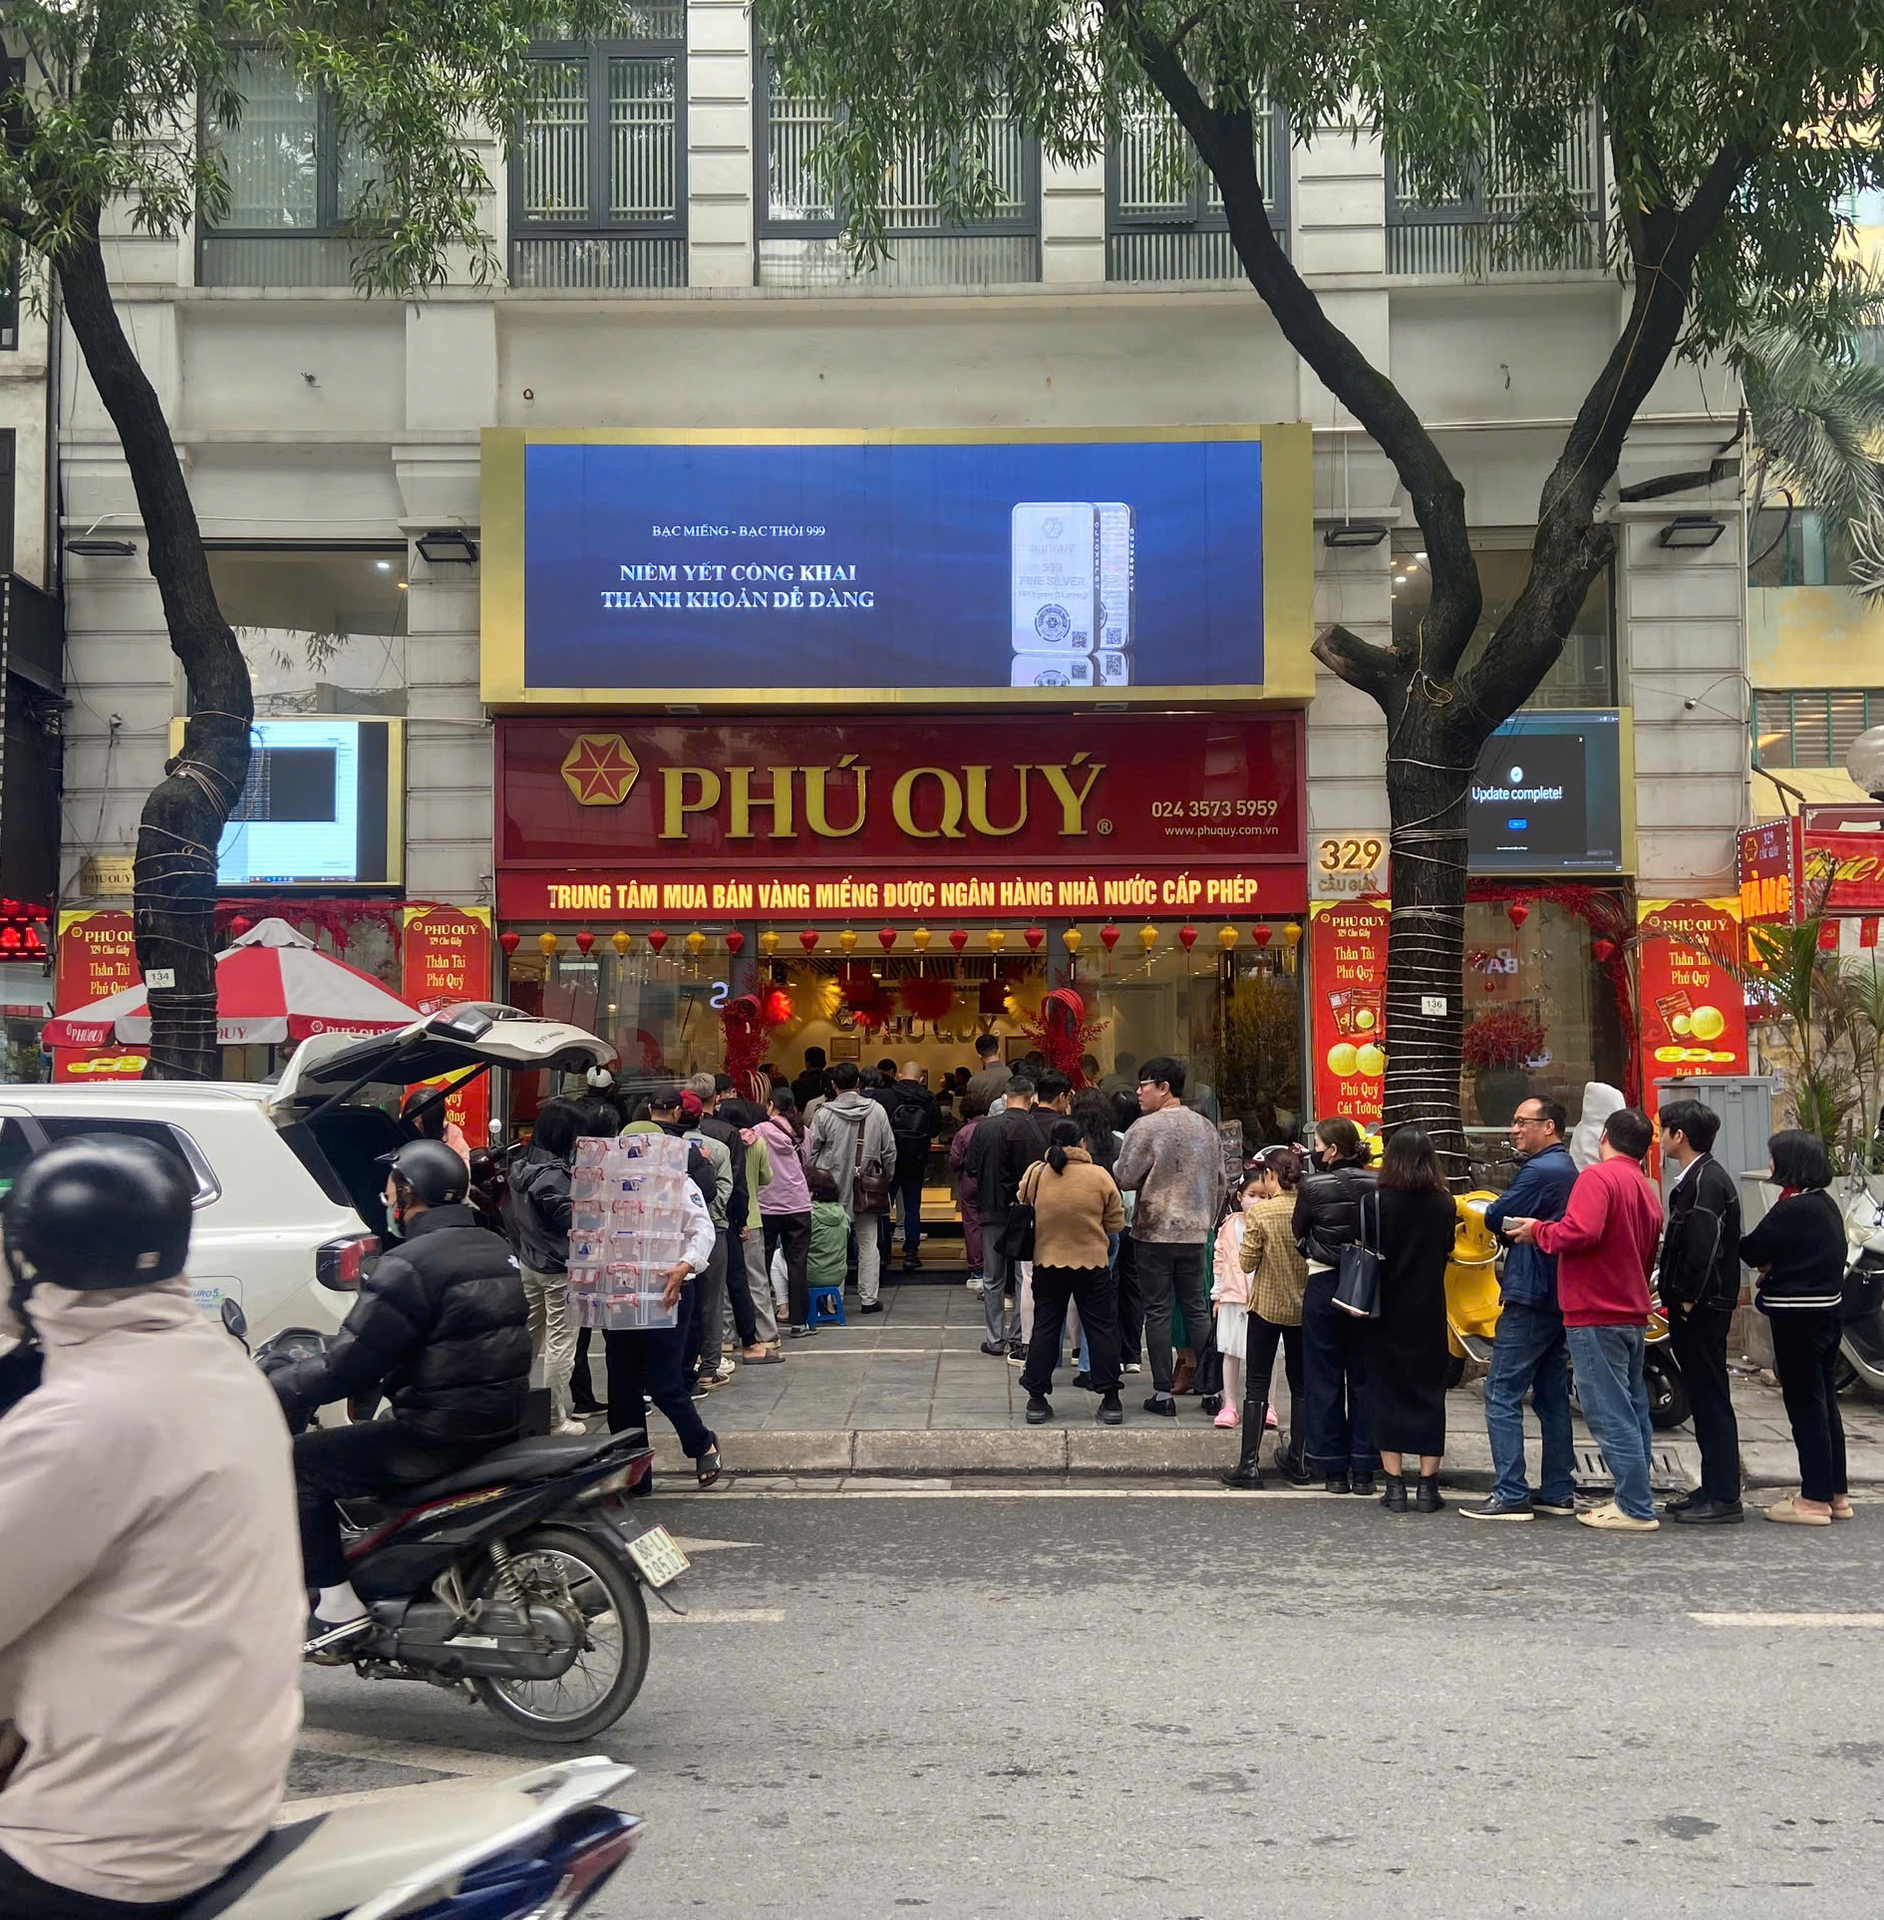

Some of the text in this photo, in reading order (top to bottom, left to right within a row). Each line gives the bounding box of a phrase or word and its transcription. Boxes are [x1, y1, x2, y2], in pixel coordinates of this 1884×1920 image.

[652, 525, 681, 538] BẠC
[683, 523, 729, 537] MIẾNG
[739, 525, 768, 538] BẠC
[806, 525, 826, 537] 999
[682, 560, 727, 582] YẾT
[730, 562, 795, 582] CÔNG
[799, 564, 857, 582] KHAI
[600, 585, 875, 609] THANH KHOẢN DỄ DÀNG
[658, 751, 1107, 840] PHÚ QUÝ
[1471, 785, 1563, 804] Update complete!
[1151, 800, 1278, 818] 024 3573 5959
[1164, 825, 1279, 838] www.phuquy.com.vn
[1320, 839, 1382, 869] 329
[1318, 873, 1346, 892] CẦU
[548, 871, 1258, 912] TRUNG TÂM MUA BÁN VÀNG MIẾNG ĐƯỢC NGÂN HÀNG NHÀ NƯỚC CẤP PHÉP
[1332, 915, 1385, 927] PHÚ QUÝ
[1695, 918, 1728, 931] QUÝ
[85, 929, 116, 942] PHÚ
[424, 923, 478, 935] PHÚ QUÝ
[1334, 945, 1375, 960] Thần Tài
[1668, 950, 1694, 966] Thần
[425, 953, 466, 968] Thần Tài
[89, 962, 130, 976] Thần Tài
[150, 972, 169, 981] 134
[1336, 964, 1375, 982] Phú Quý
[426, 972, 465, 991] Phú Quý
[1671, 970, 1711, 988] Phú Quý
[90, 980, 108, 995] Phú
[1427, 999, 1442, 1009] 136
[1341, 1081, 1379, 1099] Phú Quý
[1337, 1100, 1352, 1115] Cát
